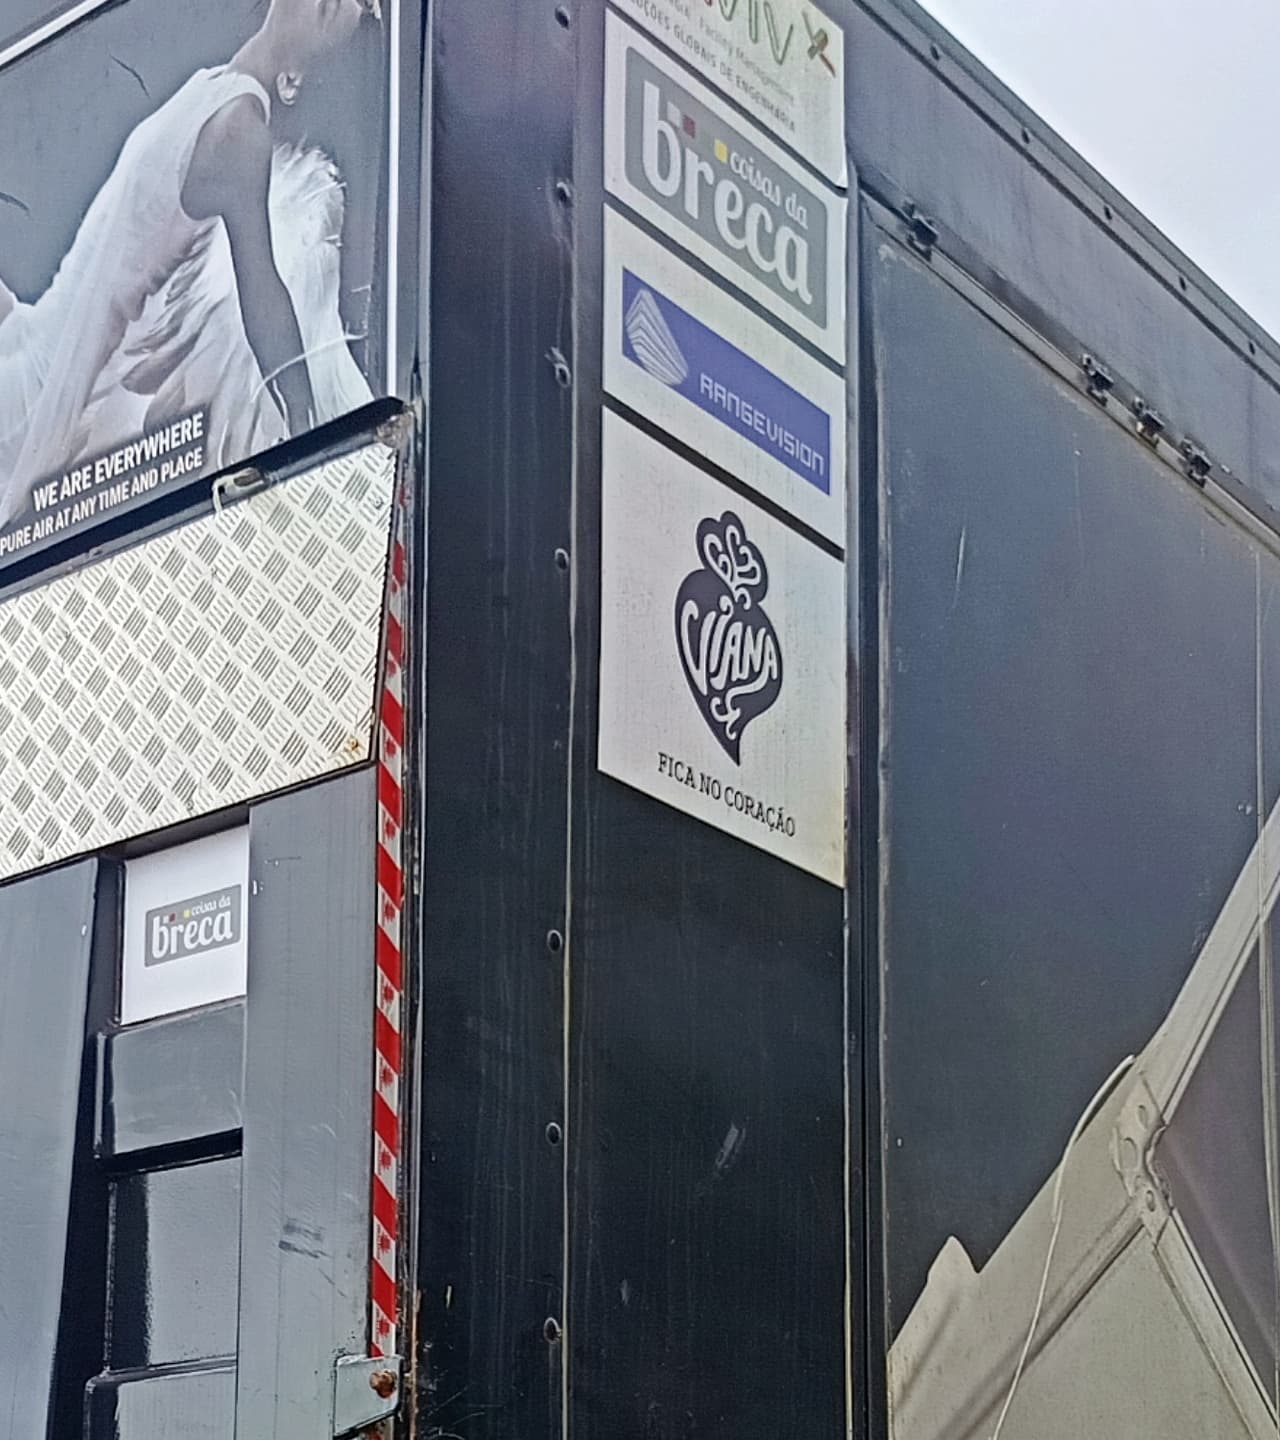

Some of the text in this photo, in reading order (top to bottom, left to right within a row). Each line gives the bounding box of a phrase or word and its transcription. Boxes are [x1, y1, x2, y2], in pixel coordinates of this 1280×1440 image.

[673, 24, 716, 67] GLOBAIS
[719, 61, 732, 82] DE
[735, 74, 796, 134] ENGENHARIA
[642, 80, 813, 305] breca
[729, 151, 808, 230] coisas da
[33, 412, 204, 513] WE ARE EVERYWHERE
[699, 371, 824, 478] RANGEVISION
[0, 529, 31, 557] PURE
[32, 513, 54, 543] AIR
[55, 506, 71, 531] AT
[71, 498, 98, 526] ANY
[98, 482, 130, 512] TIME
[130, 472, 158, 504] AND
[161, 446, 203, 483] PLACE
[680, 596, 779, 697] VIANA
[657, 751, 796, 838] FICA NO CORAÇÃO
[151, 909, 234, 959] breca
